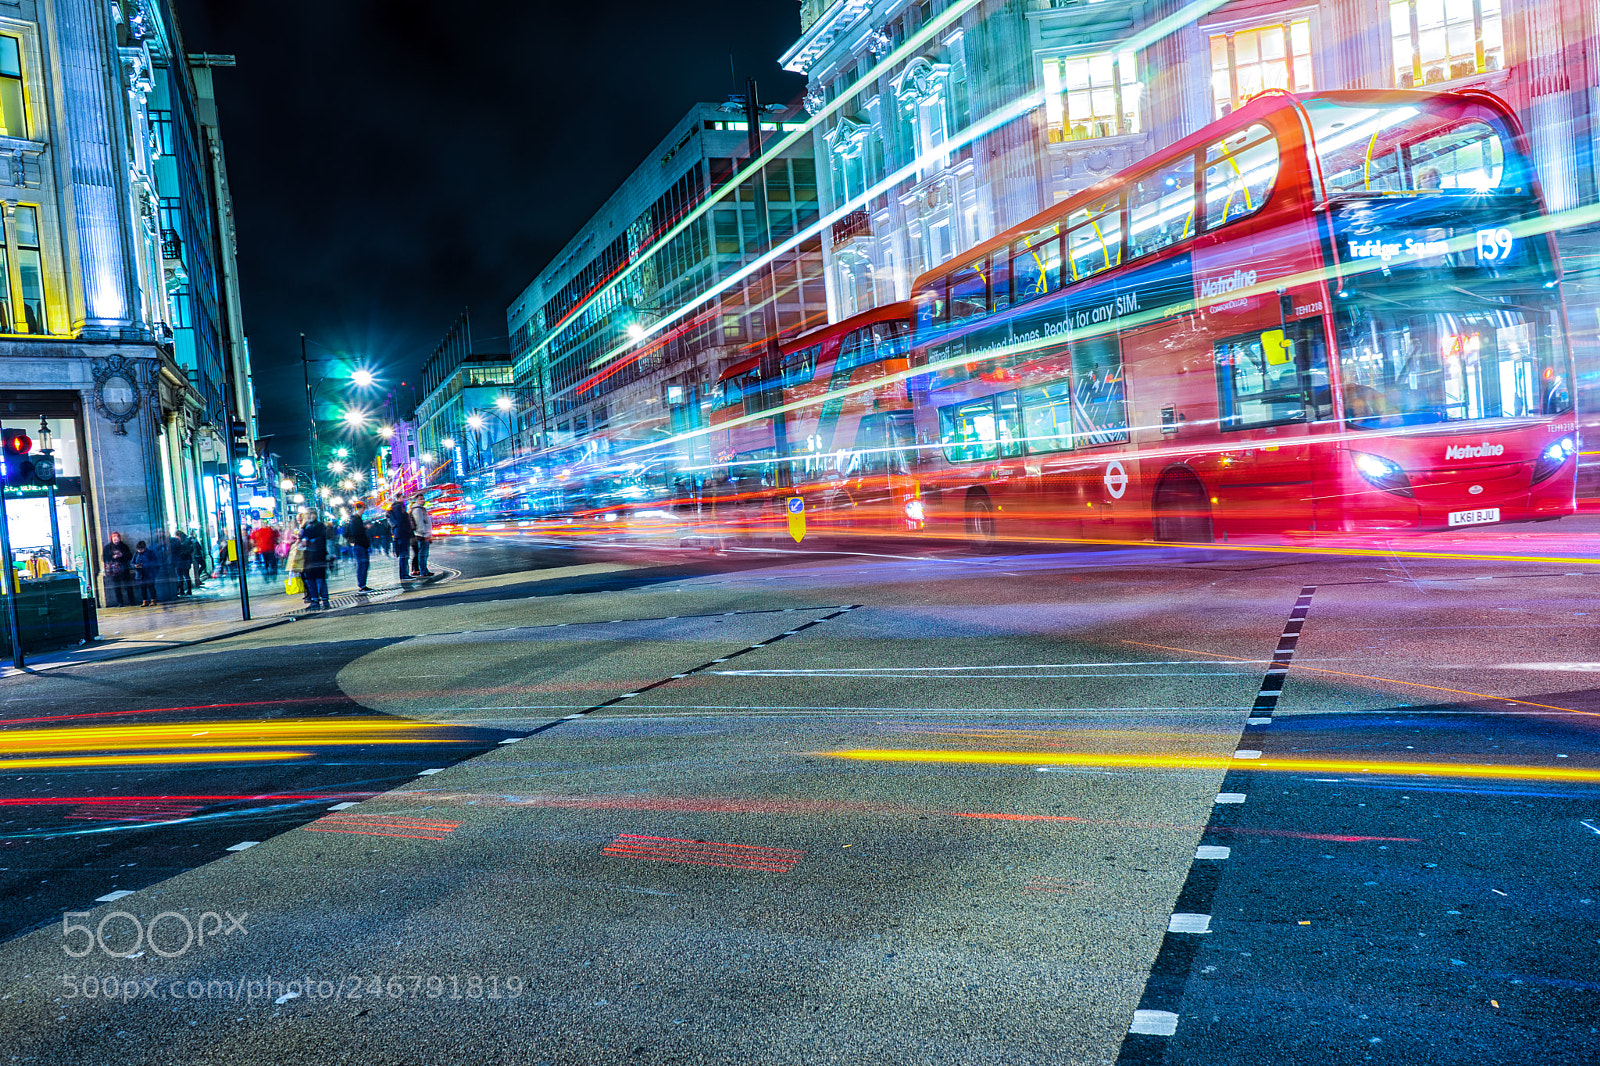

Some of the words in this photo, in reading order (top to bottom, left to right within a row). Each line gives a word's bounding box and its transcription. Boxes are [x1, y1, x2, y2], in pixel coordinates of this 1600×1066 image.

[1348, 240, 1402, 261] Trafalgar
[1476, 228, 1513, 260] 139
[1200, 269, 1258, 300] Metroline
[1294, 301, 1323, 316] TEH1218
[1008, 329, 1042, 351] phones.
[1044, 317, 1074, 339] Ready
[1076, 311, 1090, 329] for
[1092, 303, 1114, 323] any
[1116, 291, 1141, 316] SIM.
[1546, 422, 1575, 433] TEH1218
[1445, 442, 1504, 460] Metroline
[1454, 511, 1475, 524] LK61
[1477, 510, 1494, 522] BJU
